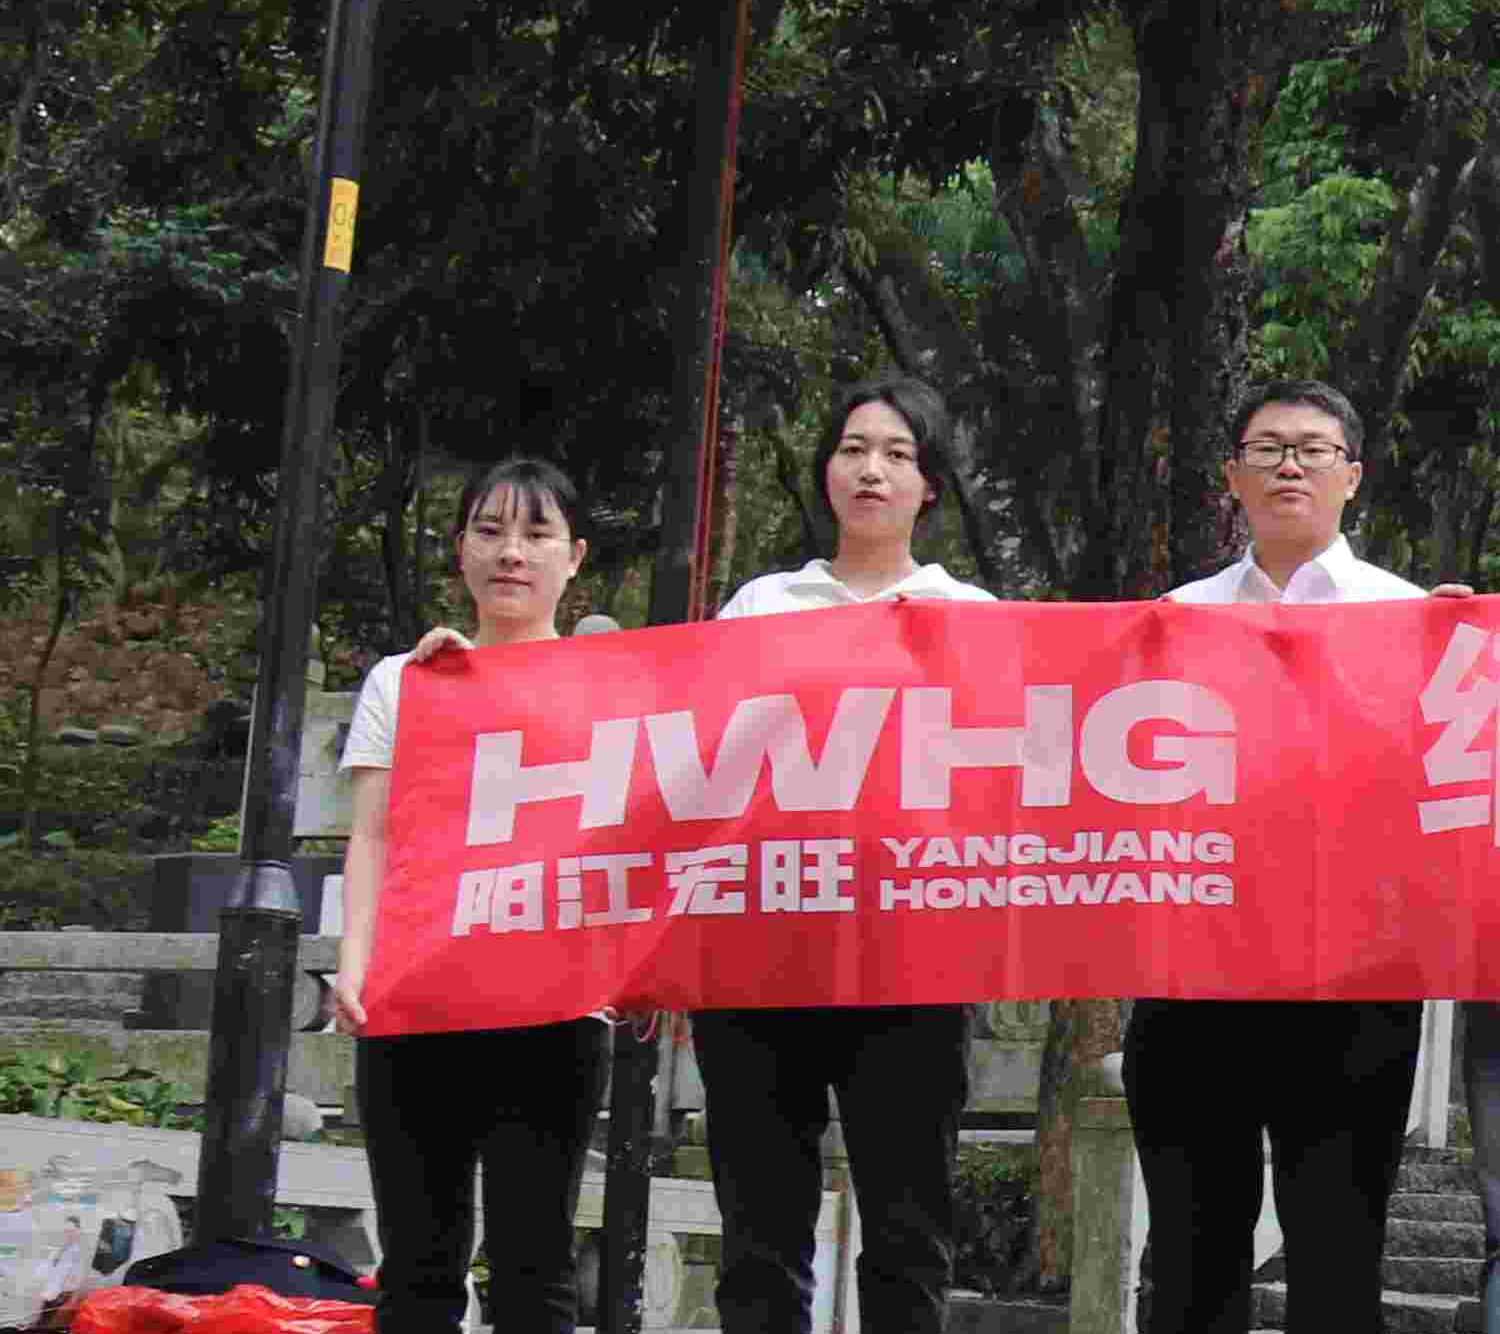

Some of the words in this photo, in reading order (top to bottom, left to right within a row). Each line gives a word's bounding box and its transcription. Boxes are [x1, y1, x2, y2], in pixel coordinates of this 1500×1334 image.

[464, 680, 1237, 847] HWHG
[880, 831, 1235, 867] YANGJIANG
[450, 838, 856, 937] 阳江宏旺
[879, 871, 1234, 910] HONGWANG
